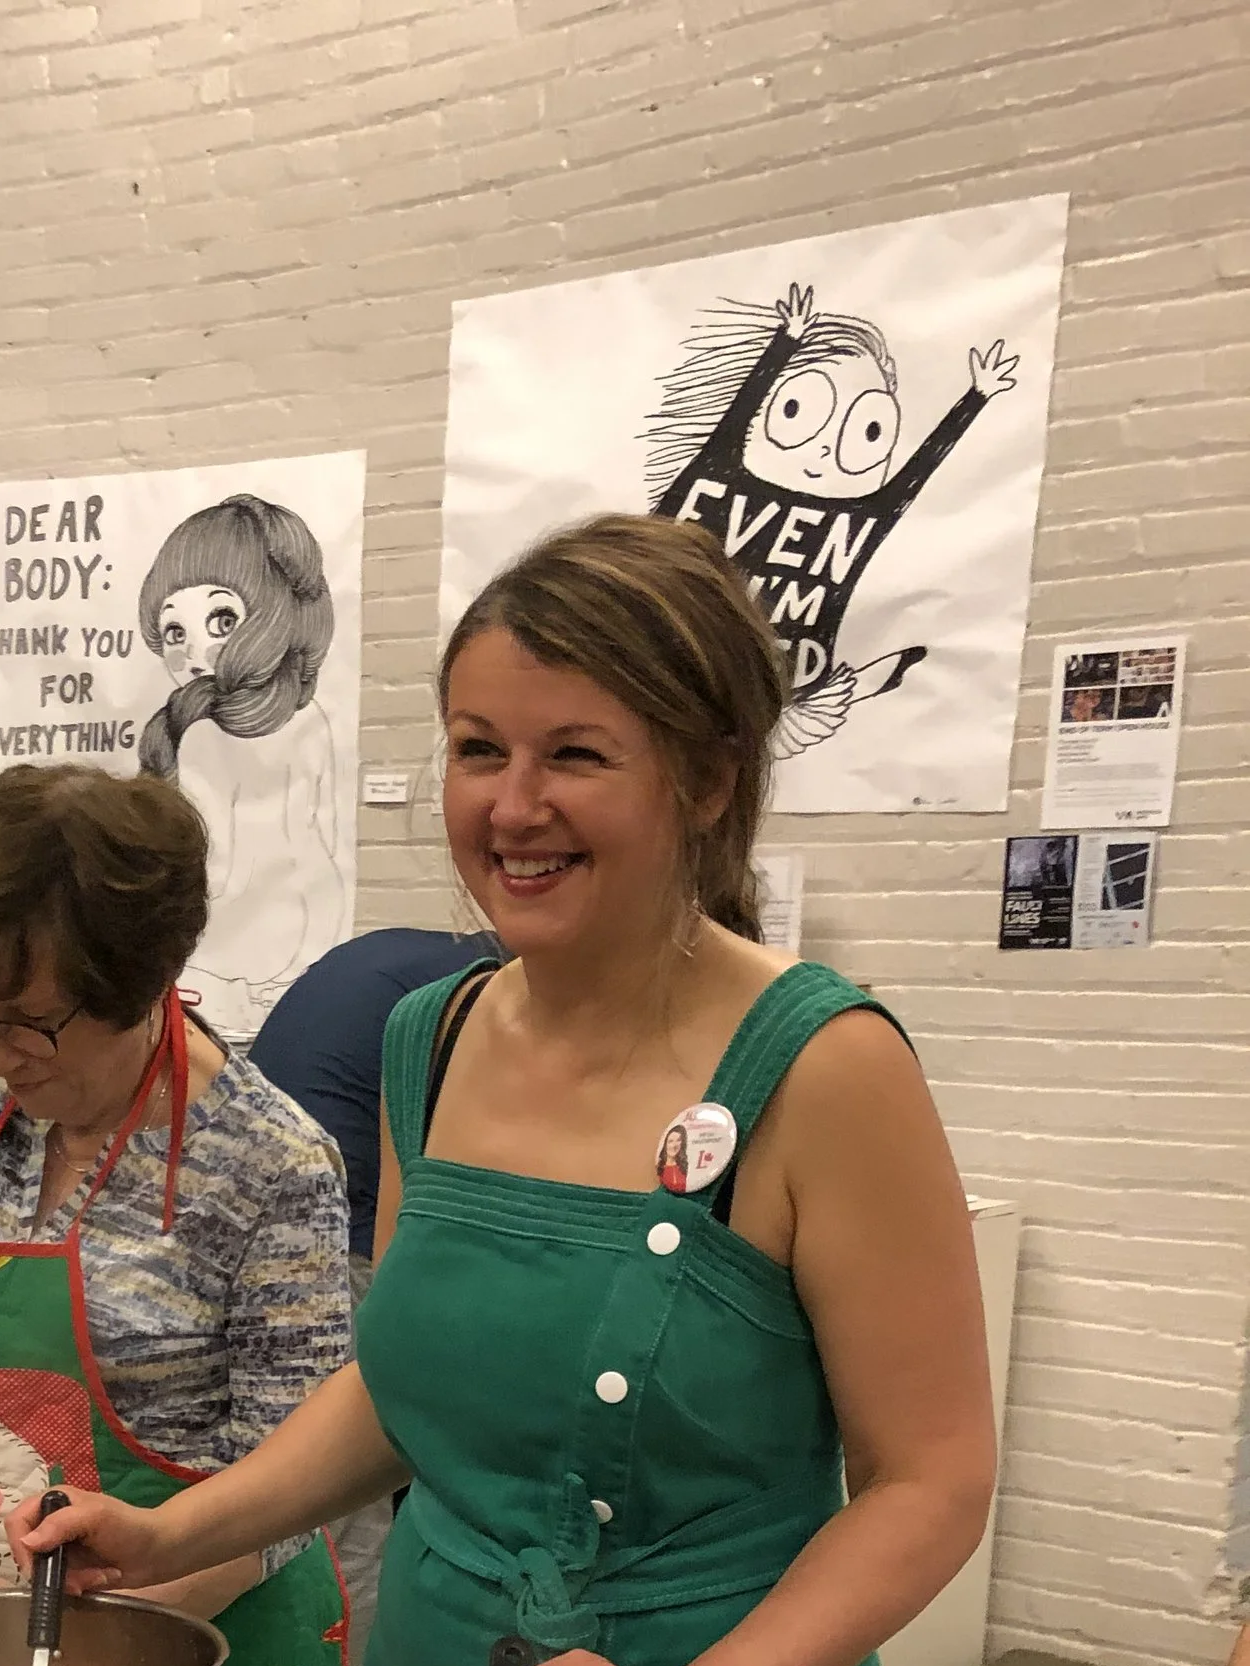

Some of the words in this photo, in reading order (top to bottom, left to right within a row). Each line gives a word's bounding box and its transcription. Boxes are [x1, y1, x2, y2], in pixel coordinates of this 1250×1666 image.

[4, 495, 104, 545] DEAR
[675, 478, 878, 585] EVEN
[4, 553, 114, 603] BODY:
[83, 627, 134, 660] YOU
[39, 672, 94, 709] FOR
